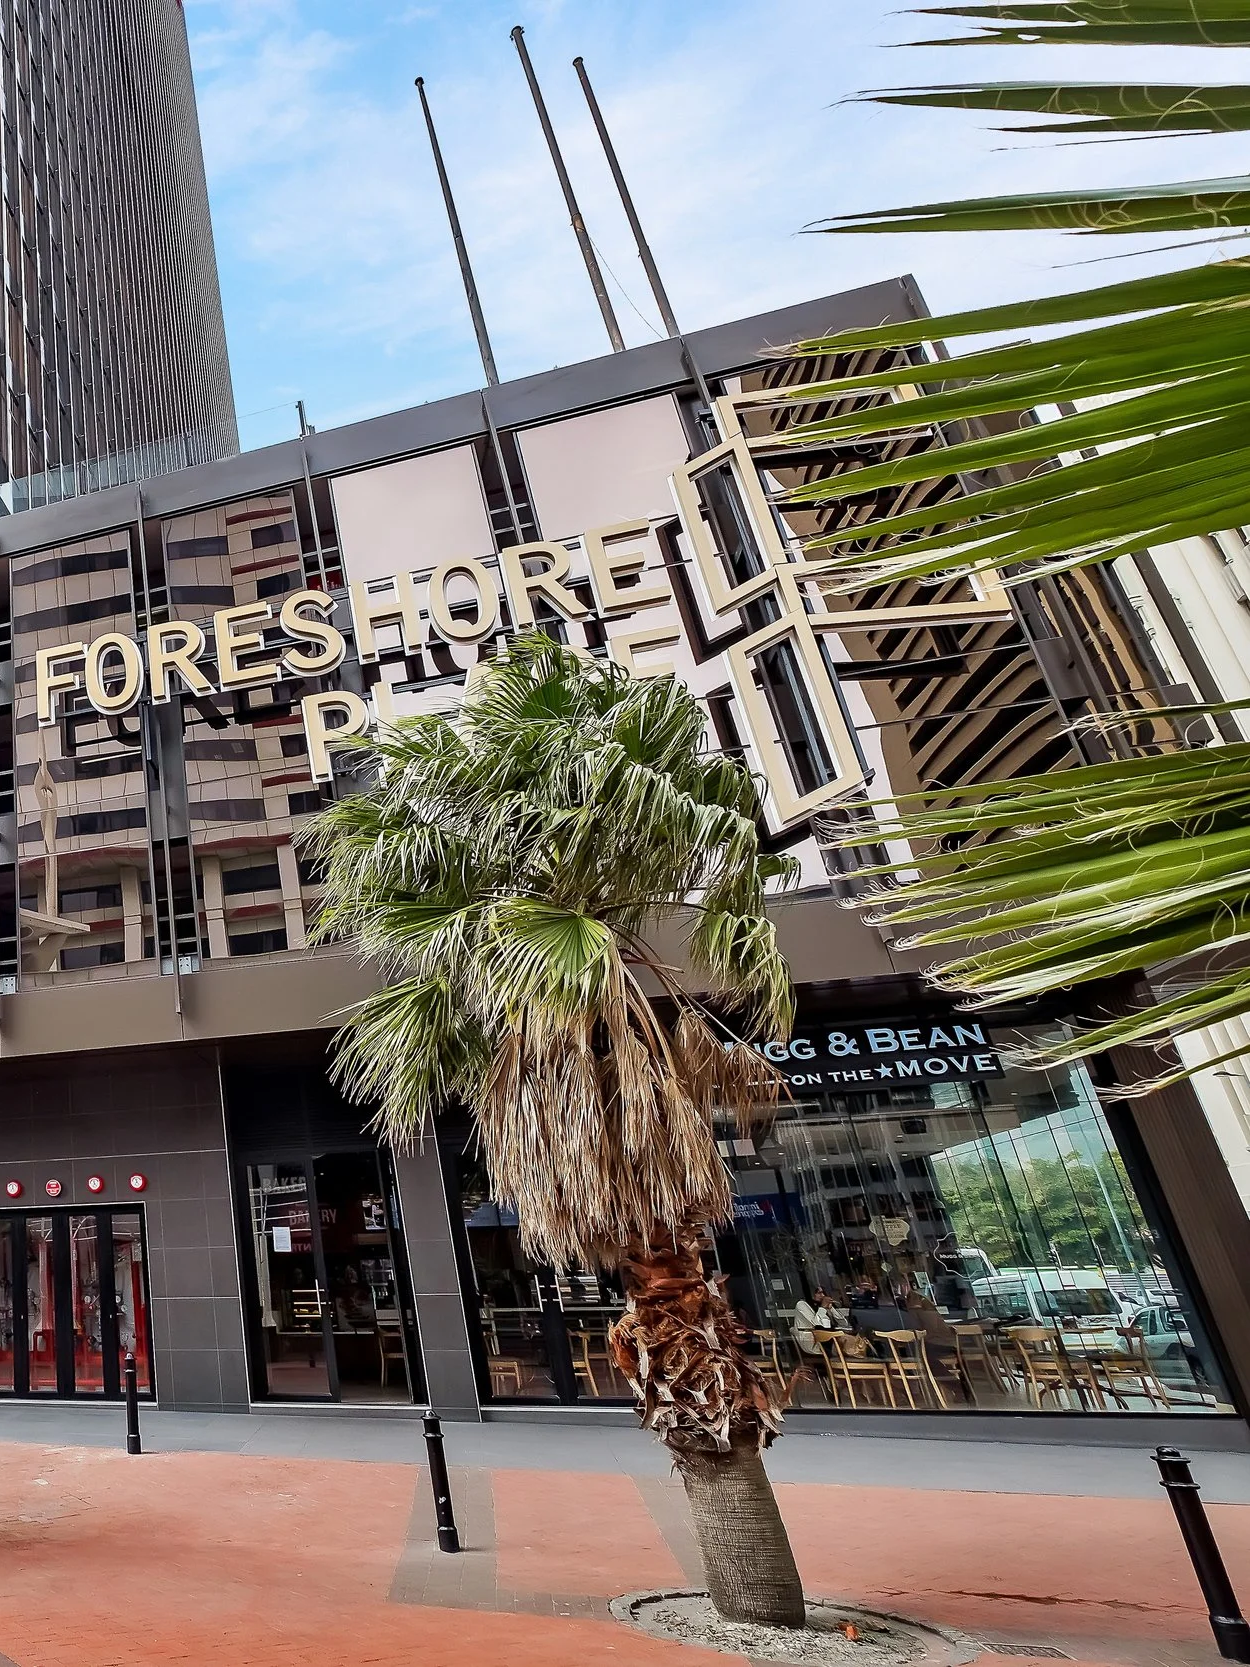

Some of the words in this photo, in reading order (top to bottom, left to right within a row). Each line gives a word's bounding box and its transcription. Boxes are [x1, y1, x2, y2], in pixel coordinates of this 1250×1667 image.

[36, 517, 673, 727] FORESHORE
[828, 1031, 860, 1057] &
[865, 1023, 987, 1054] BEAN
[791, 1073, 822, 1086] ON
[828, 1069, 874, 1083] THE
[895, 1053, 998, 1078] MOVE
